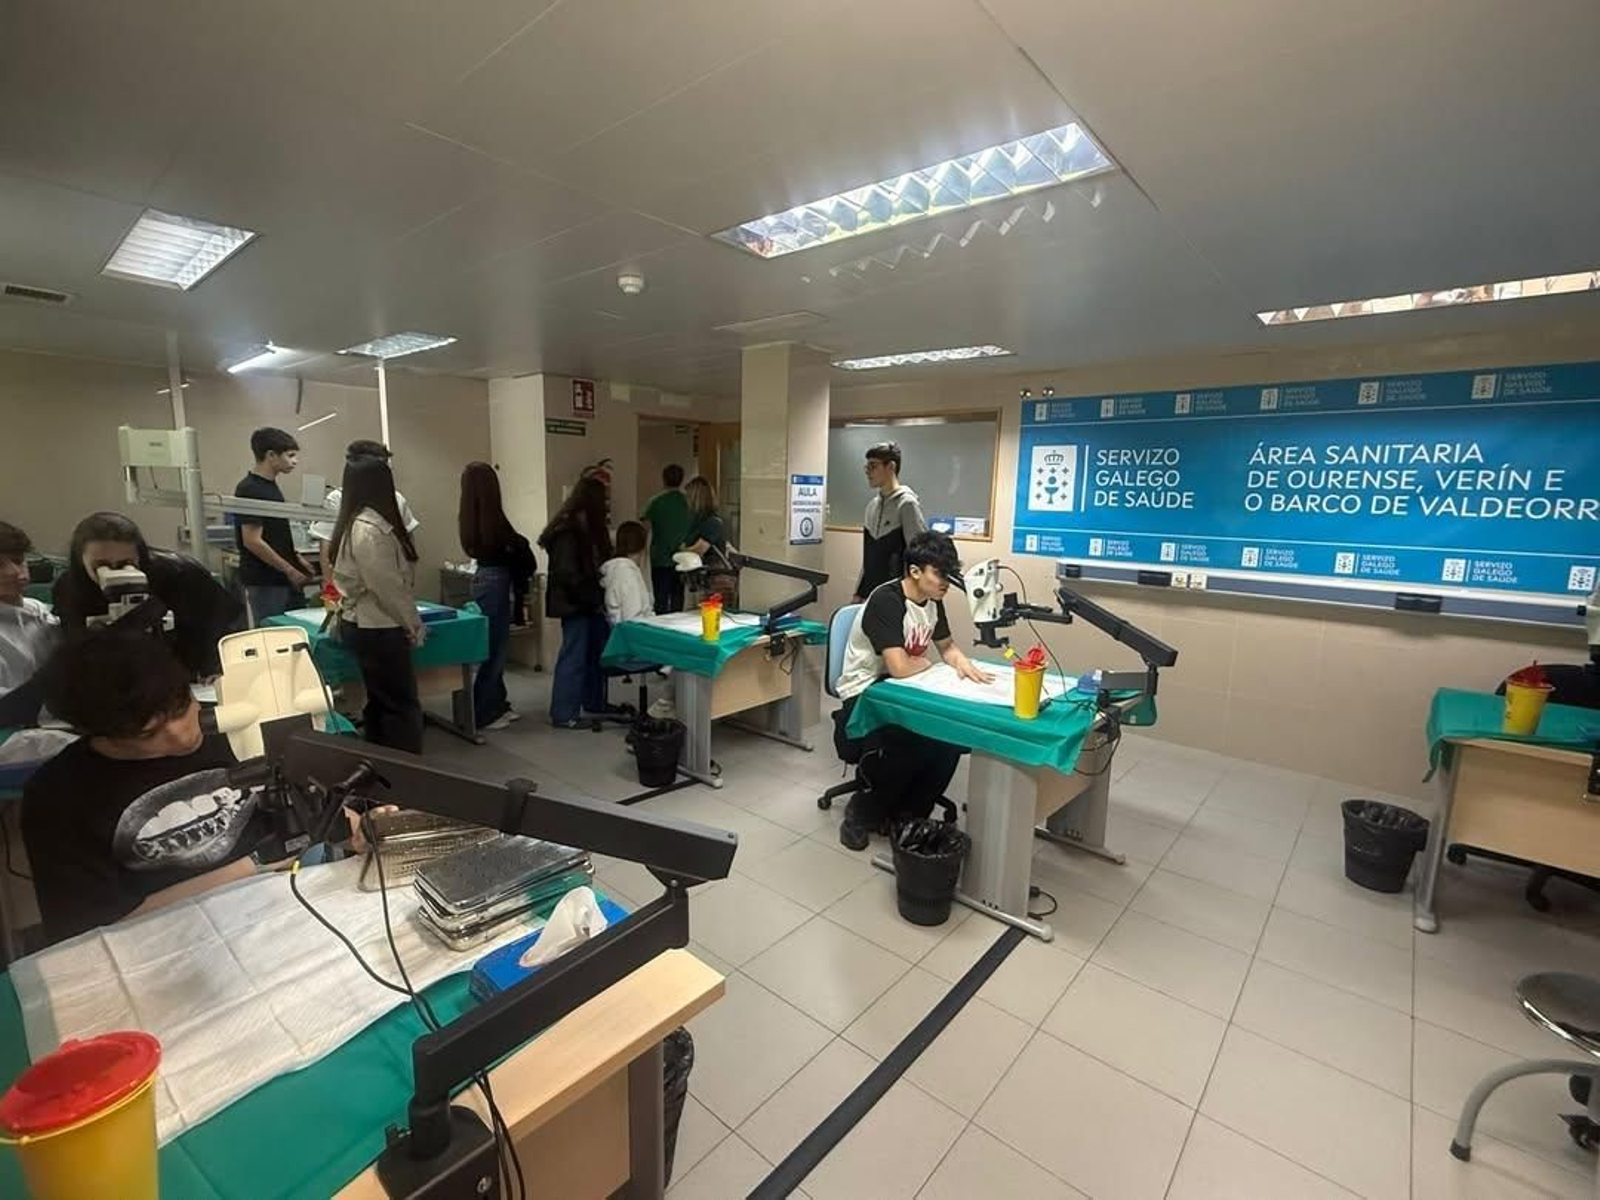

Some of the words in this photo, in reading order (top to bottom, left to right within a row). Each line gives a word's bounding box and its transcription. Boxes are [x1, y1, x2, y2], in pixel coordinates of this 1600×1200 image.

[1096, 449, 1180, 466] SERVIZO
[1248, 442, 1316, 466] ÁREA
[1324, 443, 1485, 466] SANITARIA
[1095, 470, 1180, 487] GALEGO
[1247, 470, 1280, 489] DE
[1287, 469, 1424, 493] OURENSE,
[1436, 463, 1538, 491] VERÍN
[1544, 469, 1566, 491] E
[1094, 491, 1119, 507] DE
[1124, 486, 1195, 509] SAÚDE
[1244, 493, 1264, 512] O
[1270, 493, 1362, 515] BARCO
[1370, 495, 1410, 515] DE
[1419, 496, 1600, 521] VALDEORR
